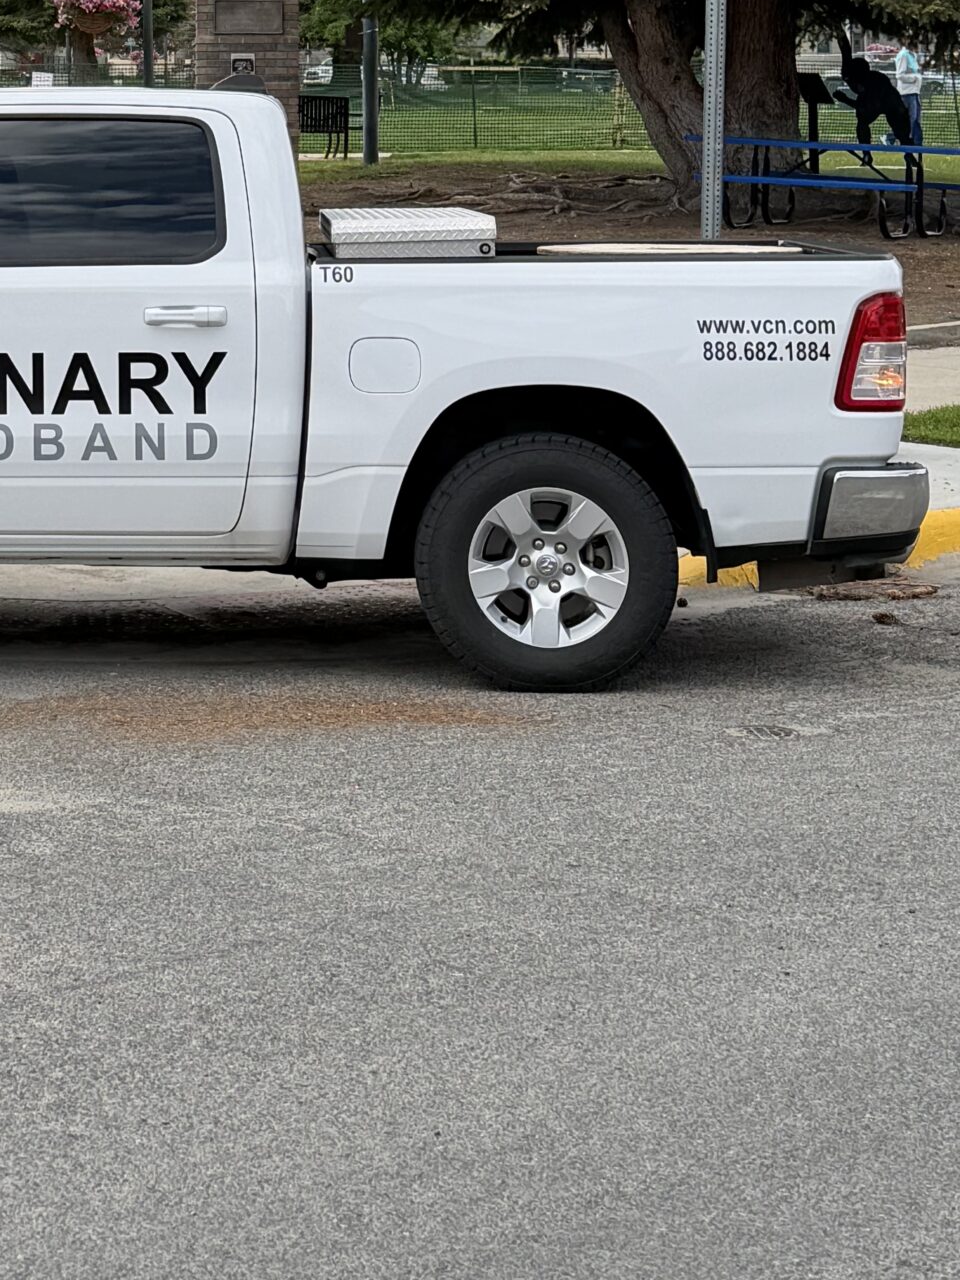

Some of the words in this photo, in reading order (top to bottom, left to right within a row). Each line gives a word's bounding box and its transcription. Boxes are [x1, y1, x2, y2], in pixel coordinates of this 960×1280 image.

[319, 266, 354, 283] T60
[696, 319, 836, 335] www.vcn.com
[702, 341, 831, 362] 888.682.1884
